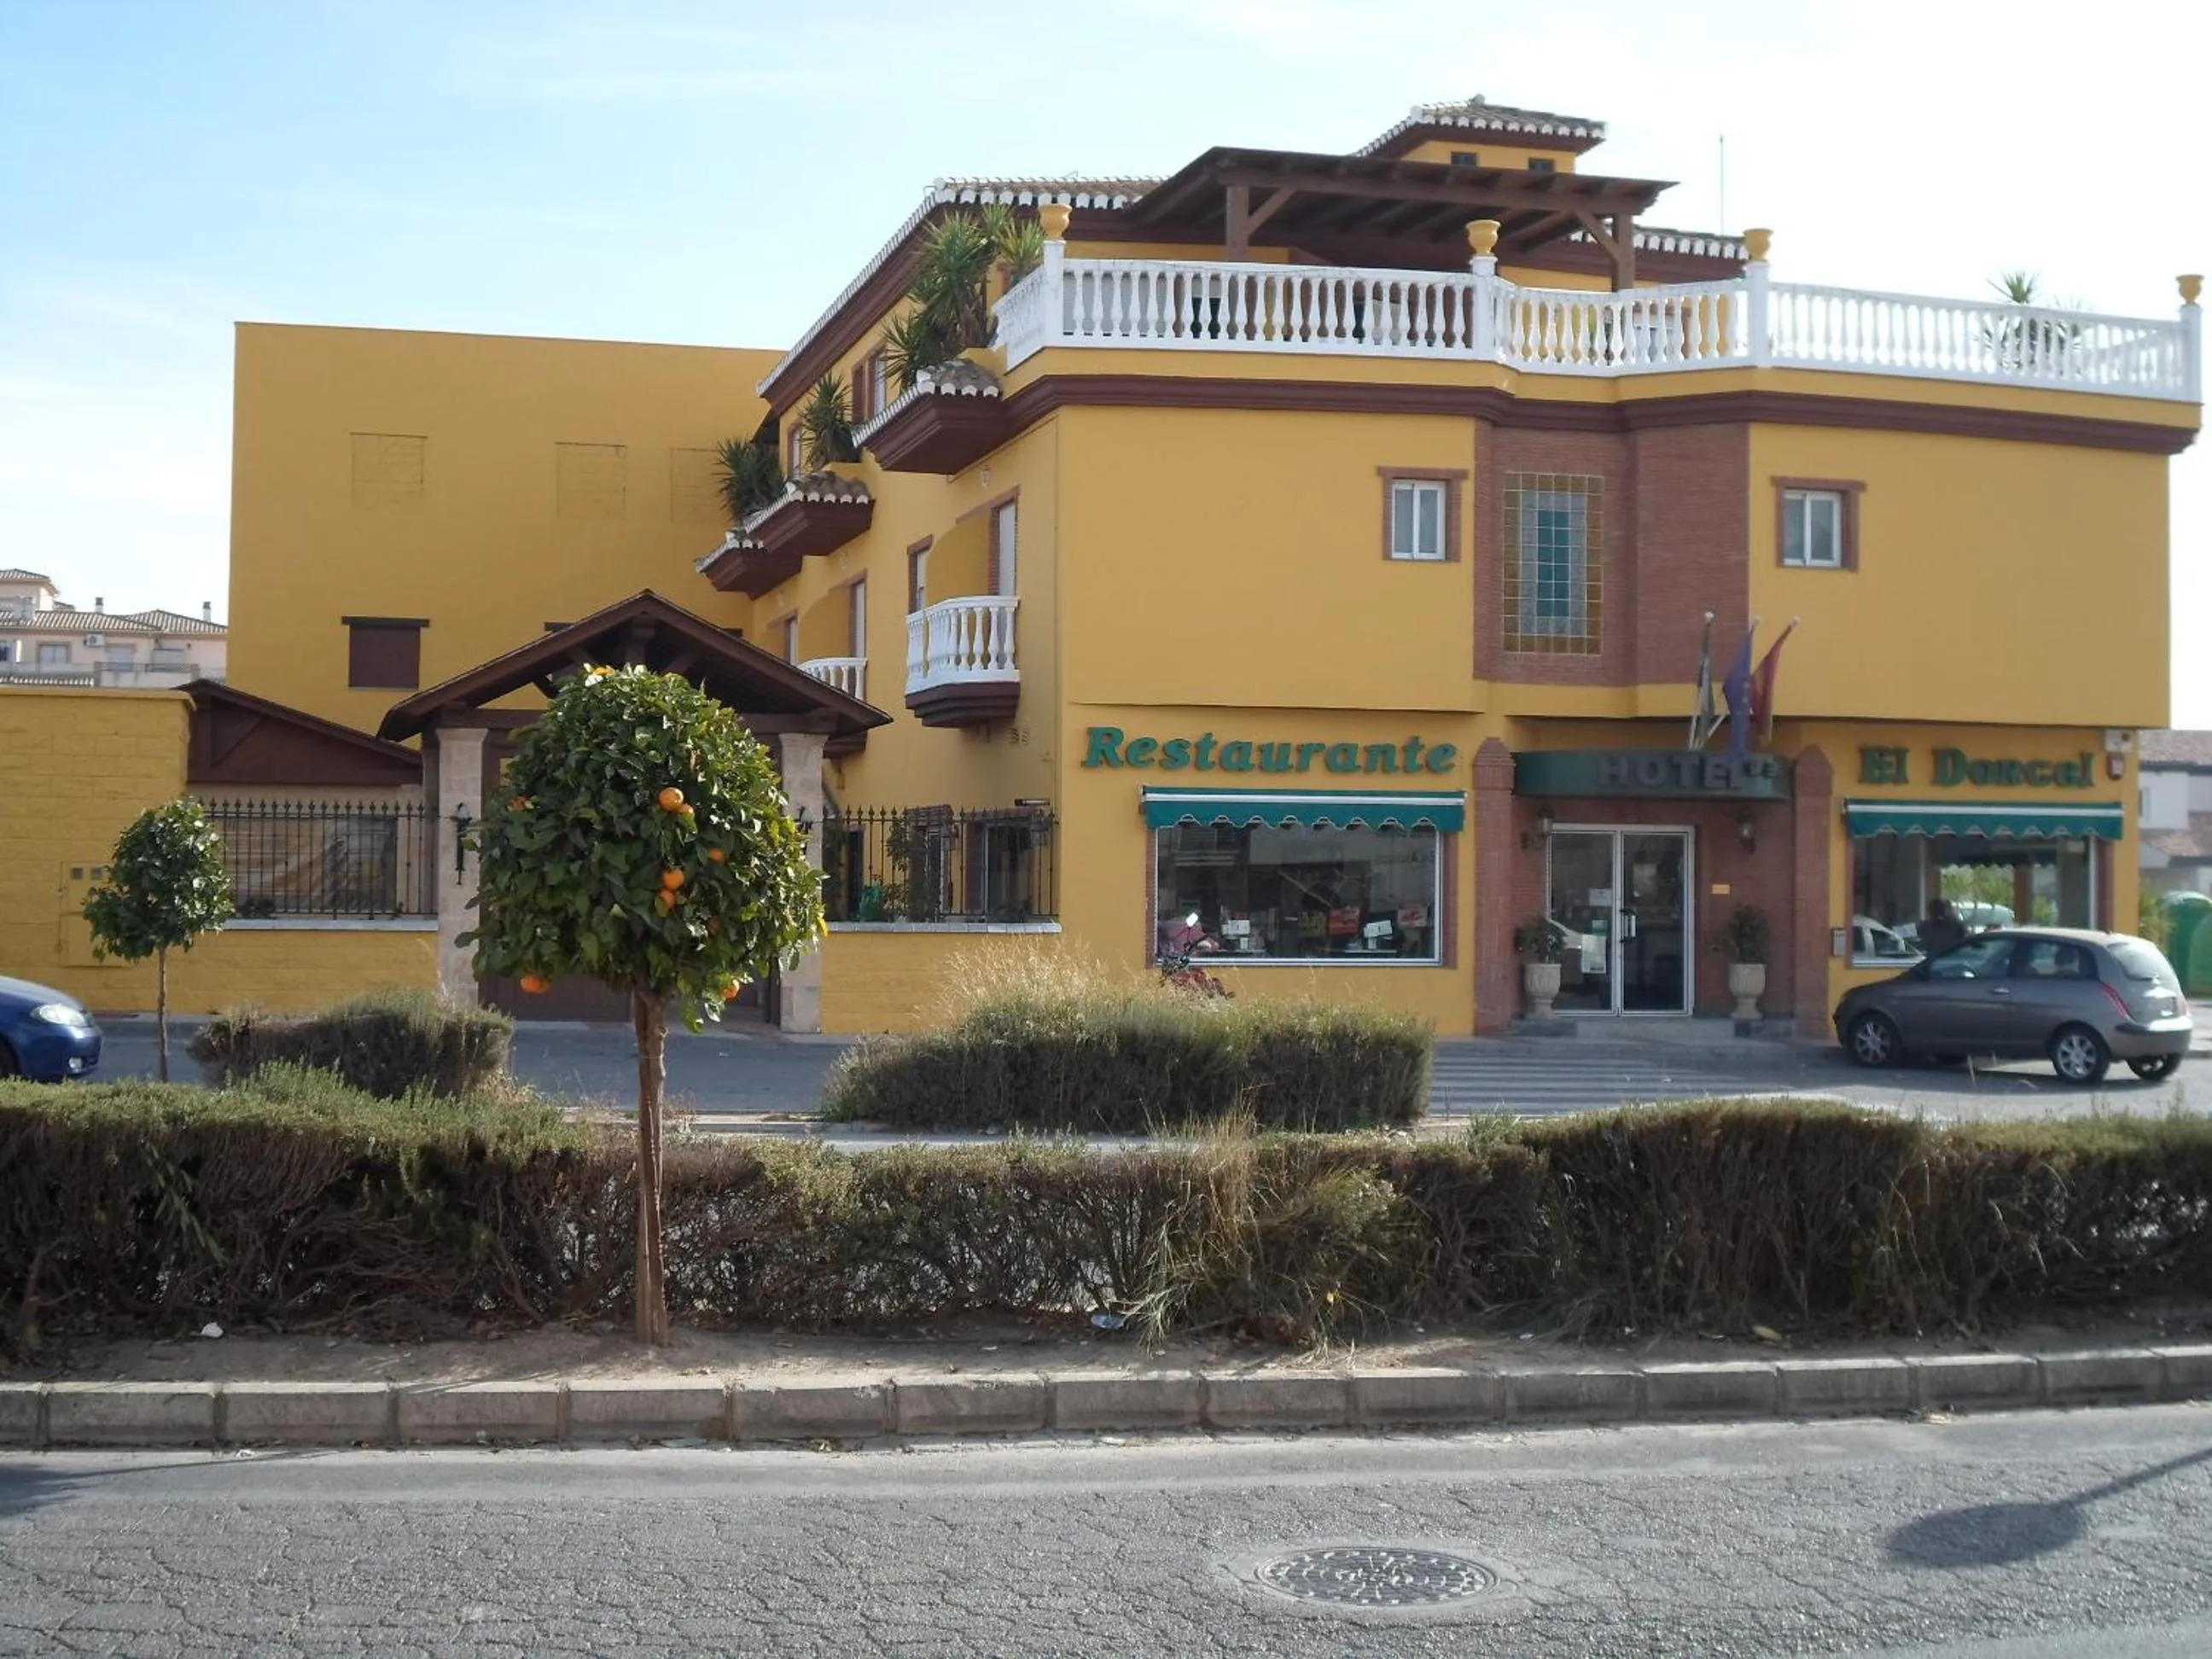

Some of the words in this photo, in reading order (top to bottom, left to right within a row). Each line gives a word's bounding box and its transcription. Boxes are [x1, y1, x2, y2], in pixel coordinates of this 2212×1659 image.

[1081, 726, 1458, 774] Restaurante
[1860, 747, 1909, 784] El
[1598, 754, 1746, 789] HOTEL
